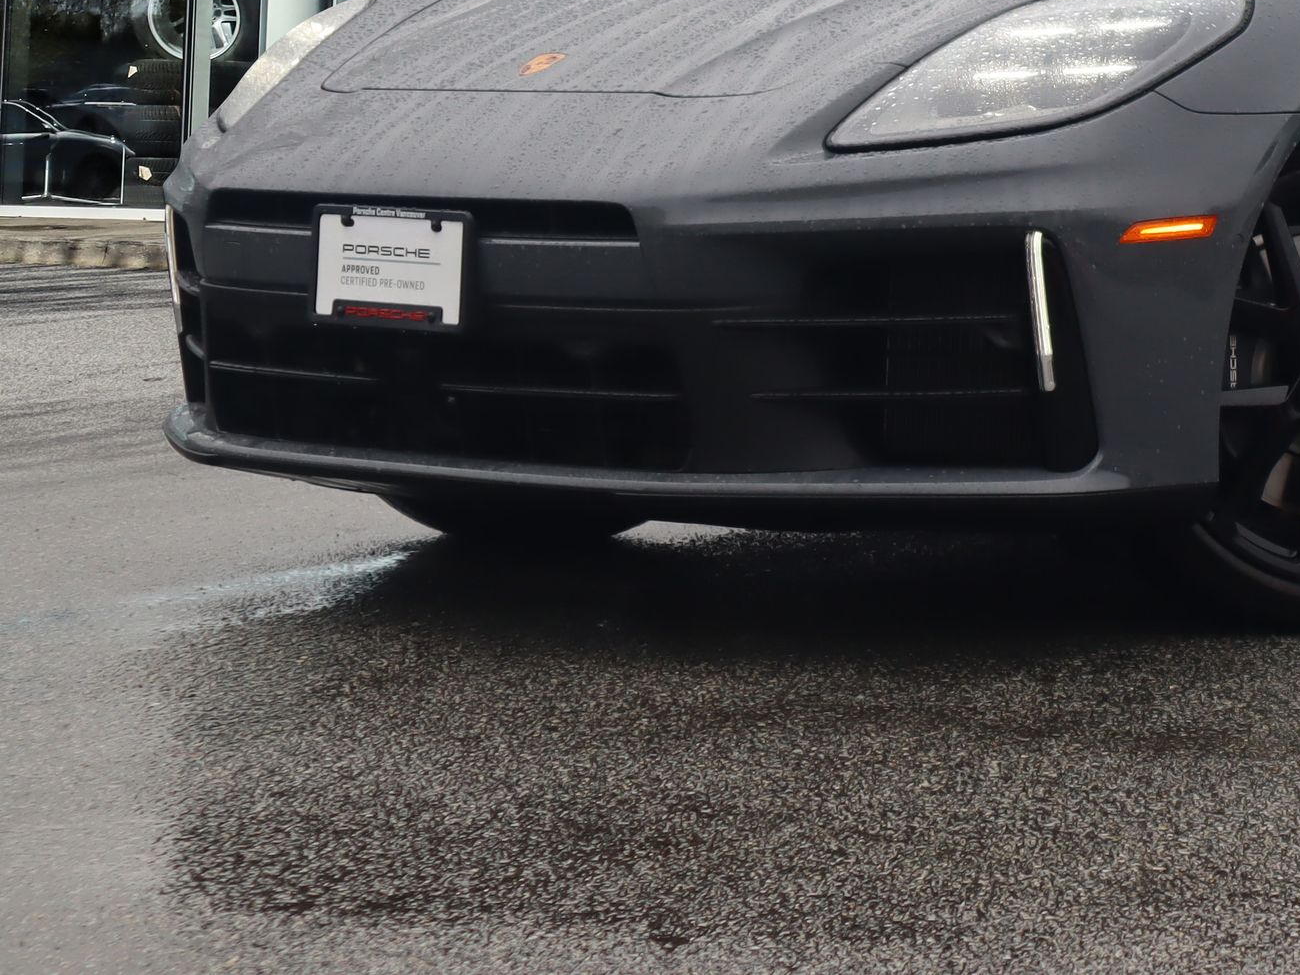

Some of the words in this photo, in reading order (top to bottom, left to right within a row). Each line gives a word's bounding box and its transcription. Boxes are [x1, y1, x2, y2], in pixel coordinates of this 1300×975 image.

[353, 206, 376, 216] Porsche
[376, 207, 396, 217] Centre
[396, 209, 427, 219] Vancouver
[342, 244, 431, 259] PORSCHE
[341, 265, 380, 275] APPROVED
[340, 276, 377, 288] CERTIFIED
[379, 279, 425, 291] PRE-OWNED
[345, 306, 427, 321] PORSCHE
